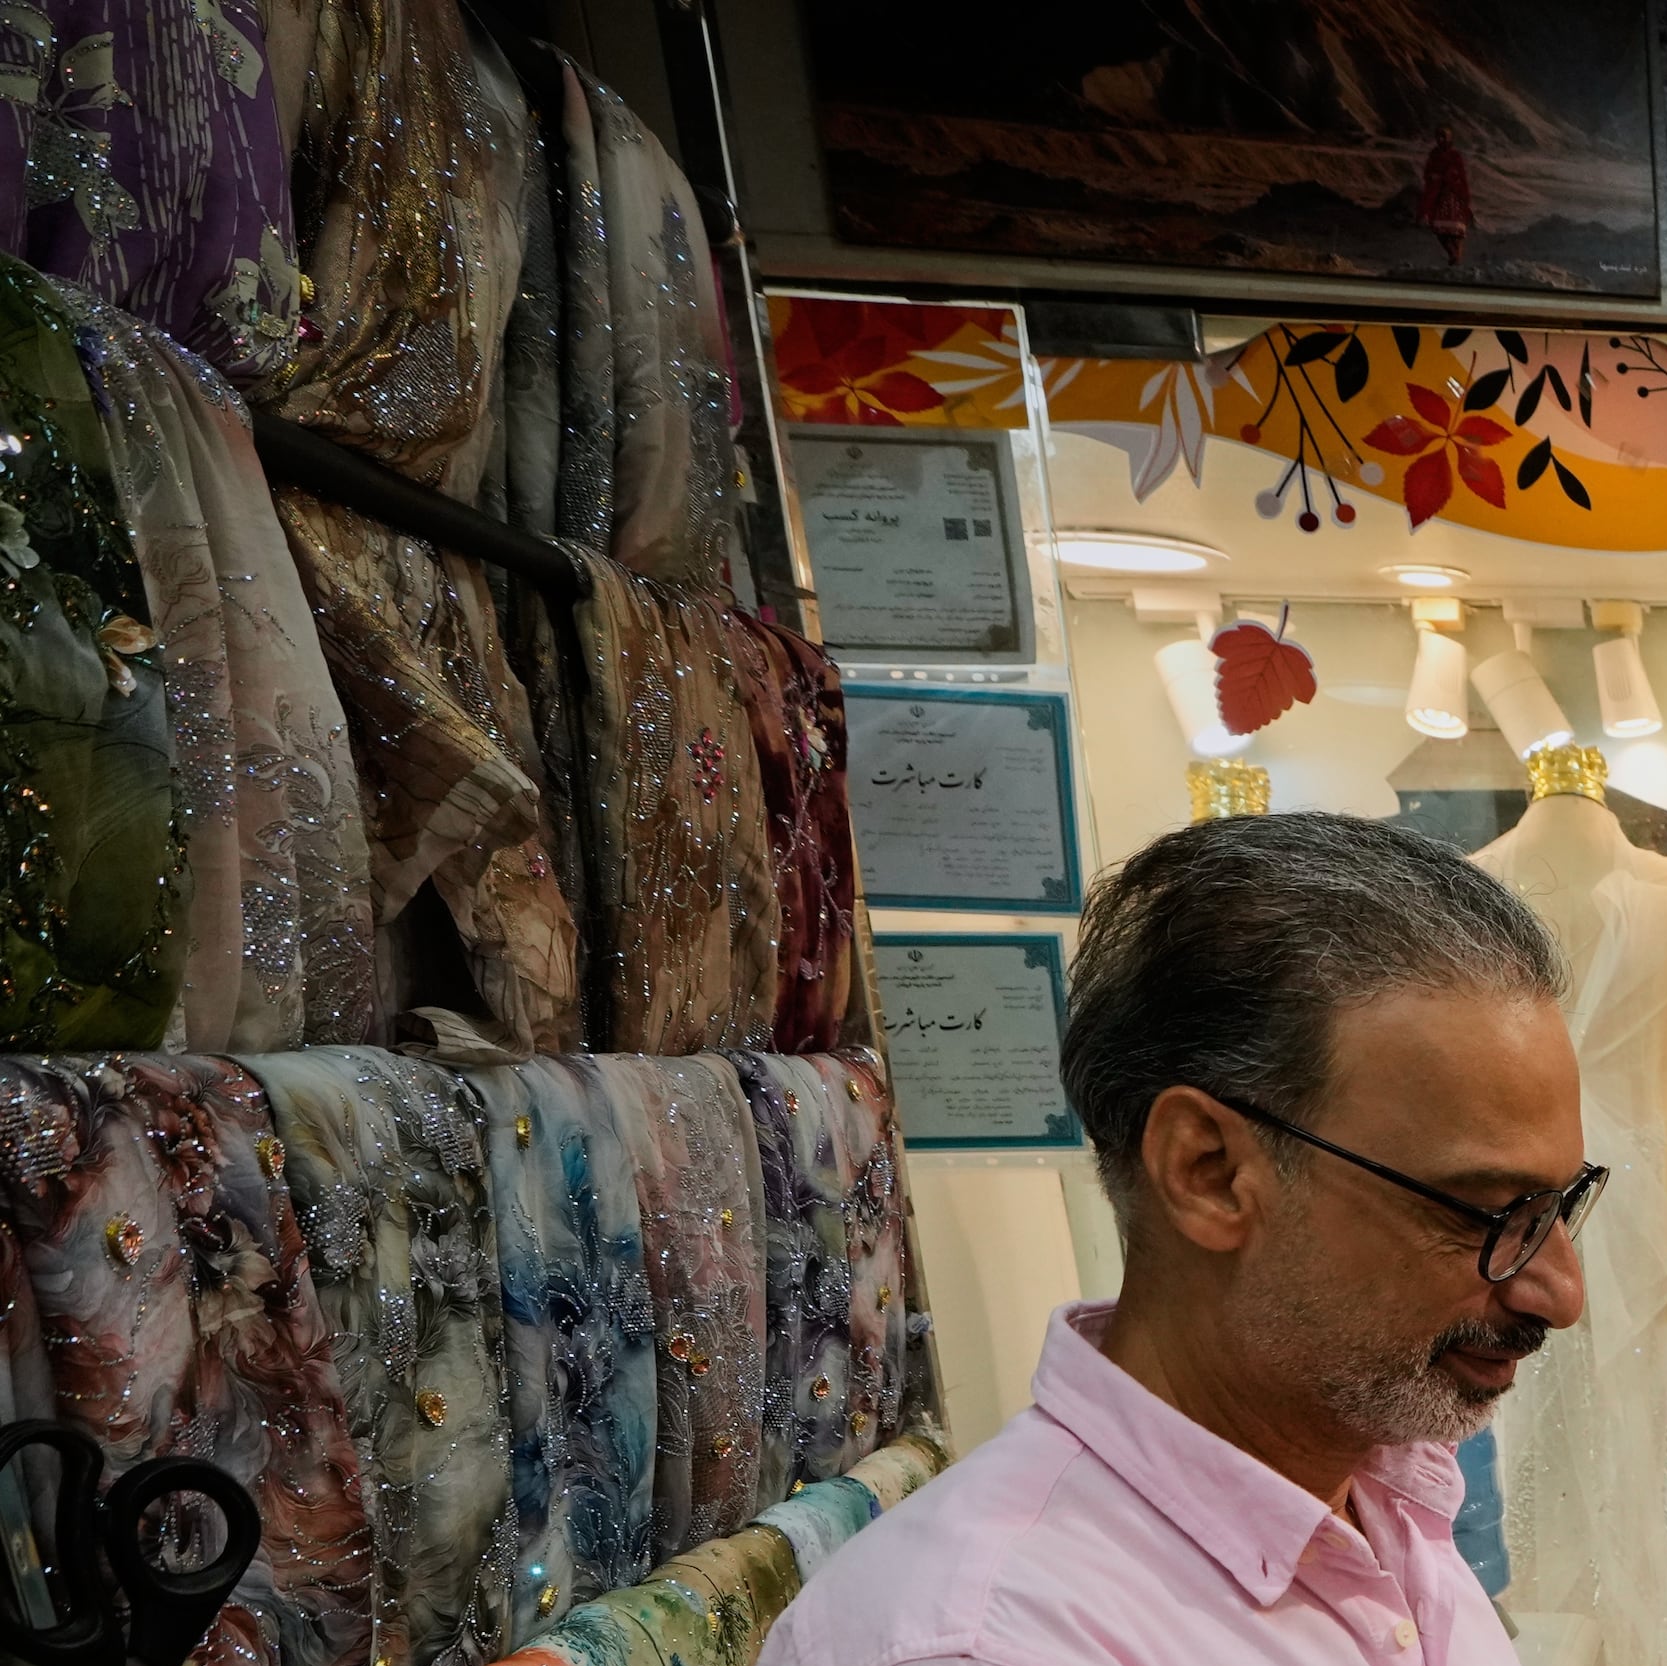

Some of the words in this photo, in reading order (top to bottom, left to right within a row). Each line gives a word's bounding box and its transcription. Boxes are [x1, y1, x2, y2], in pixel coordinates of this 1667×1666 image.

[871, 763, 936, 793] مباشرت
[938, 767, 987, 790] کارت
[938, 1007, 987, 1031] کارت
